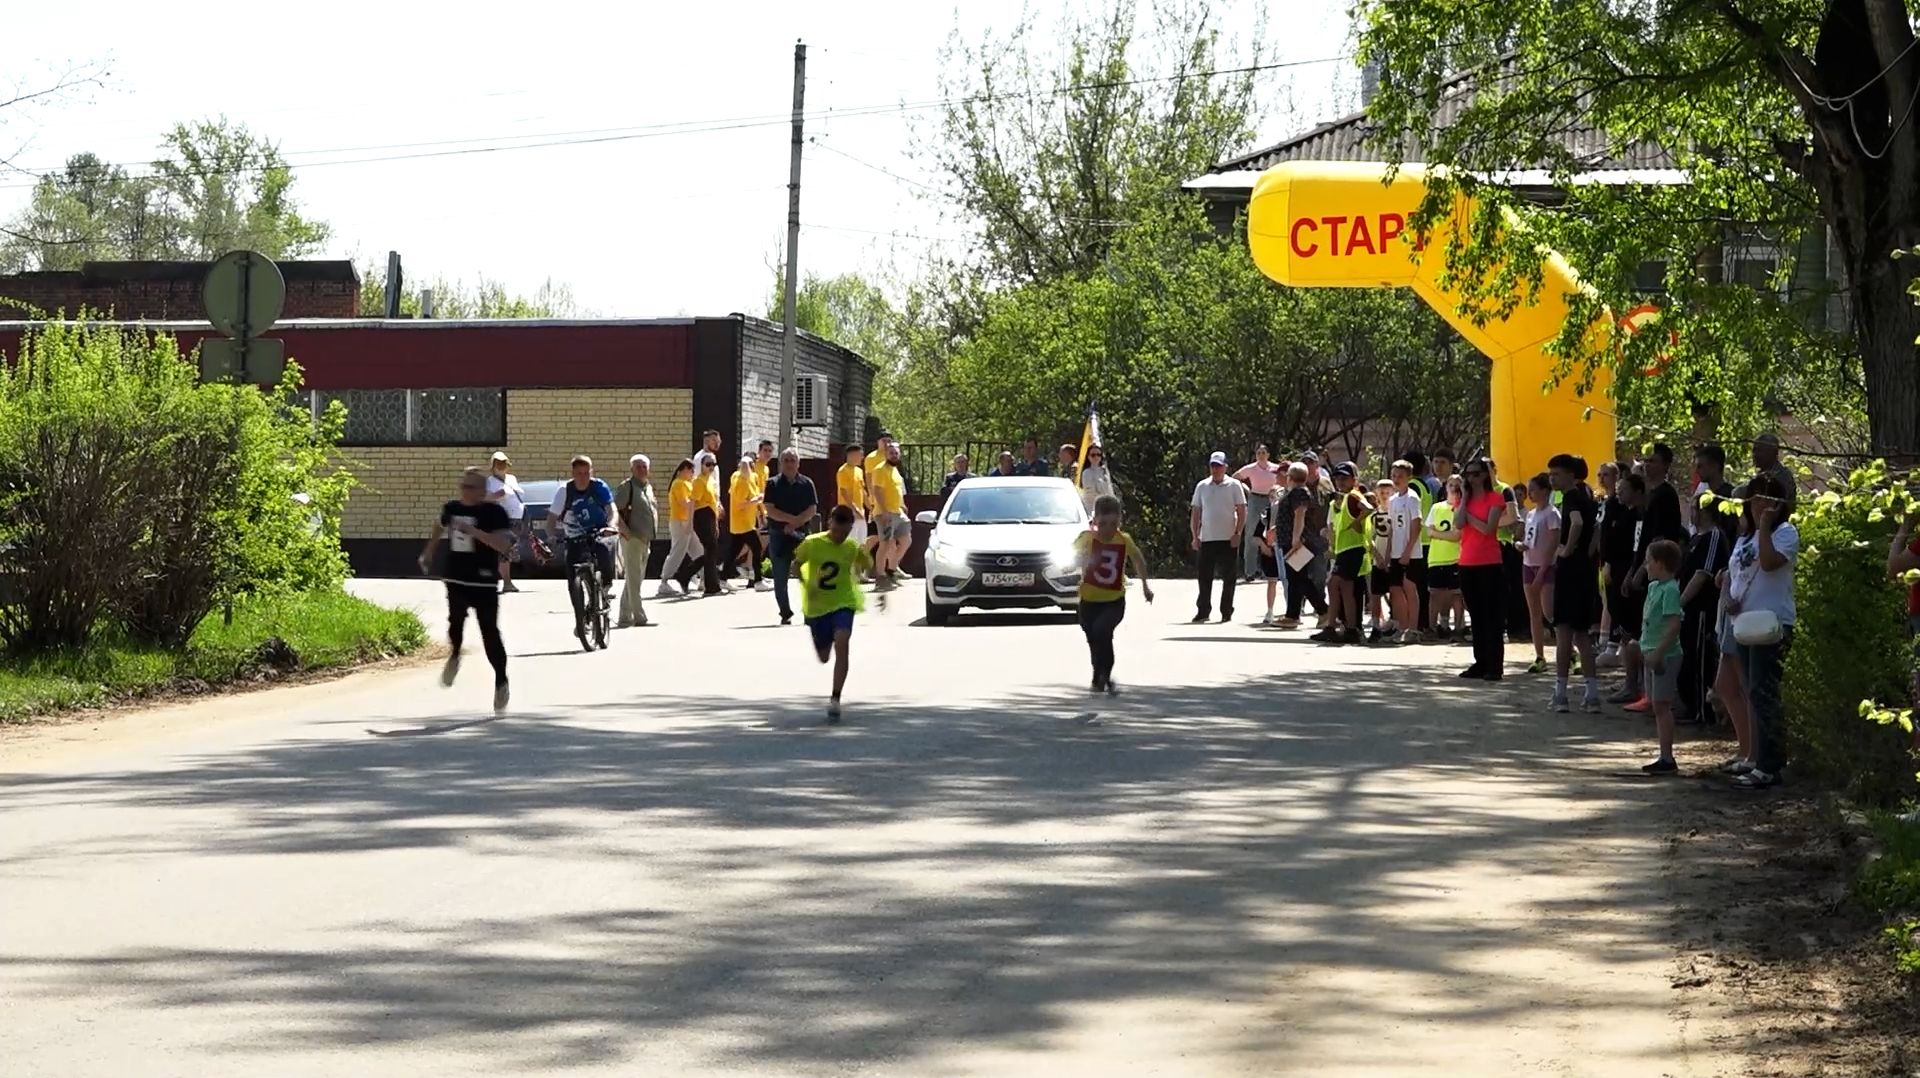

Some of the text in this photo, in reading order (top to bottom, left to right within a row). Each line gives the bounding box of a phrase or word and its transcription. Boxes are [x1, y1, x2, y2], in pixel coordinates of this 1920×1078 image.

[1397, 515, 1404, 528] 5
[1526, 526, 1535, 541] 5
[818, 561, 840, 590] 2
[1093, 550, 1119, 585] 3
